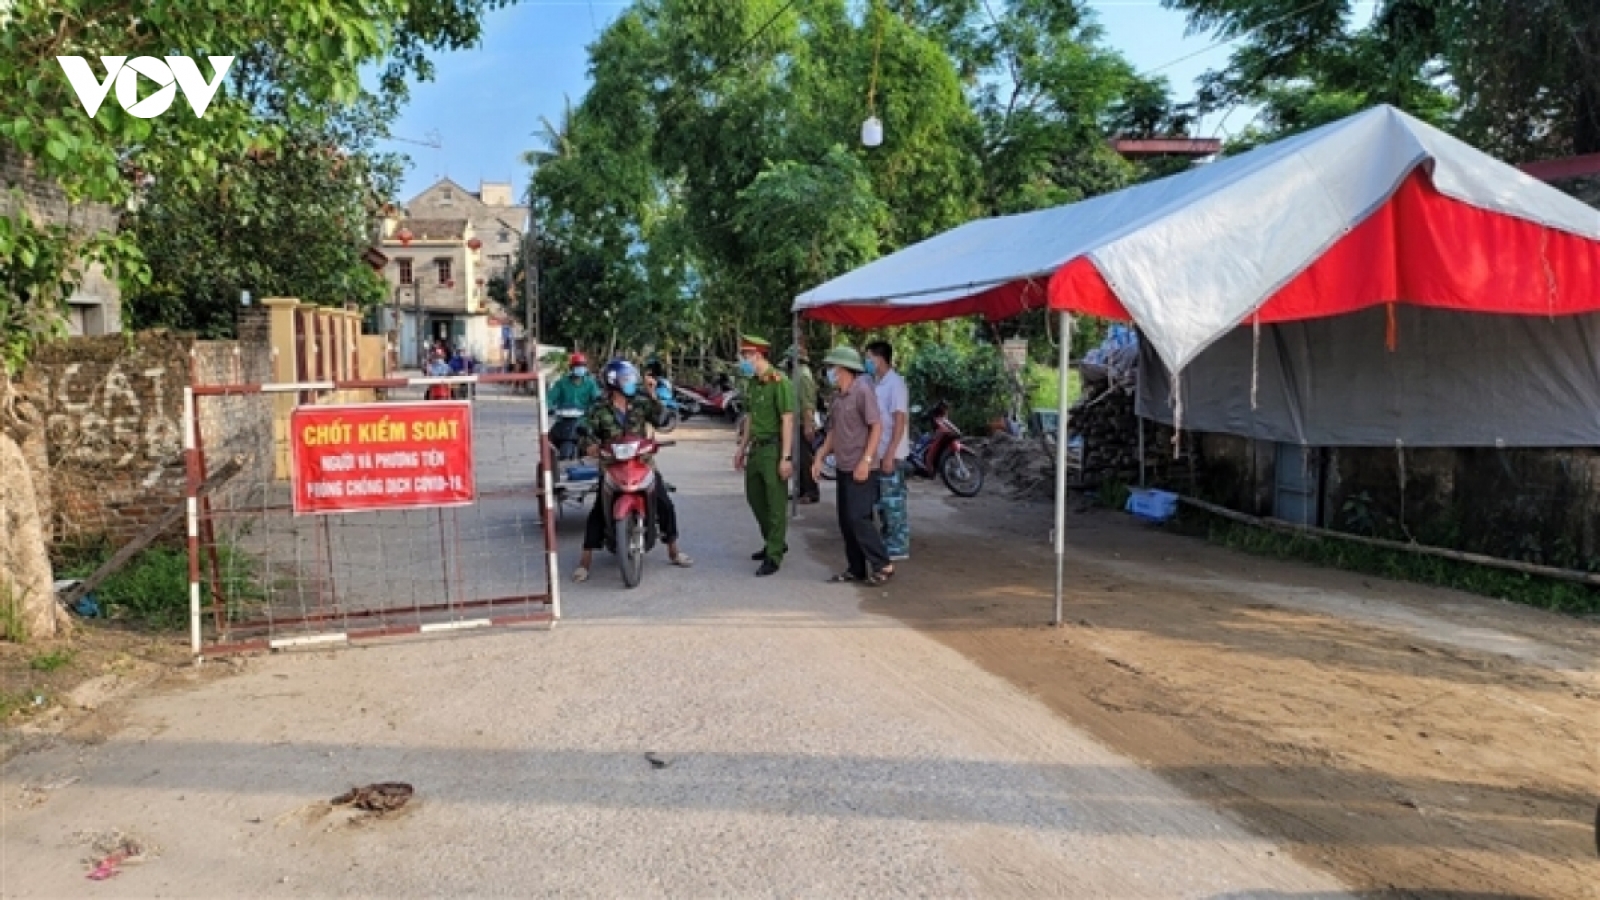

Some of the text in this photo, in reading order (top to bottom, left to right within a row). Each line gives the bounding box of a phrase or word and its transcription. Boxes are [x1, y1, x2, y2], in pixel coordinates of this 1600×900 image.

[303, 415, 459, 445] CHỐT KIỂM SOÁT
